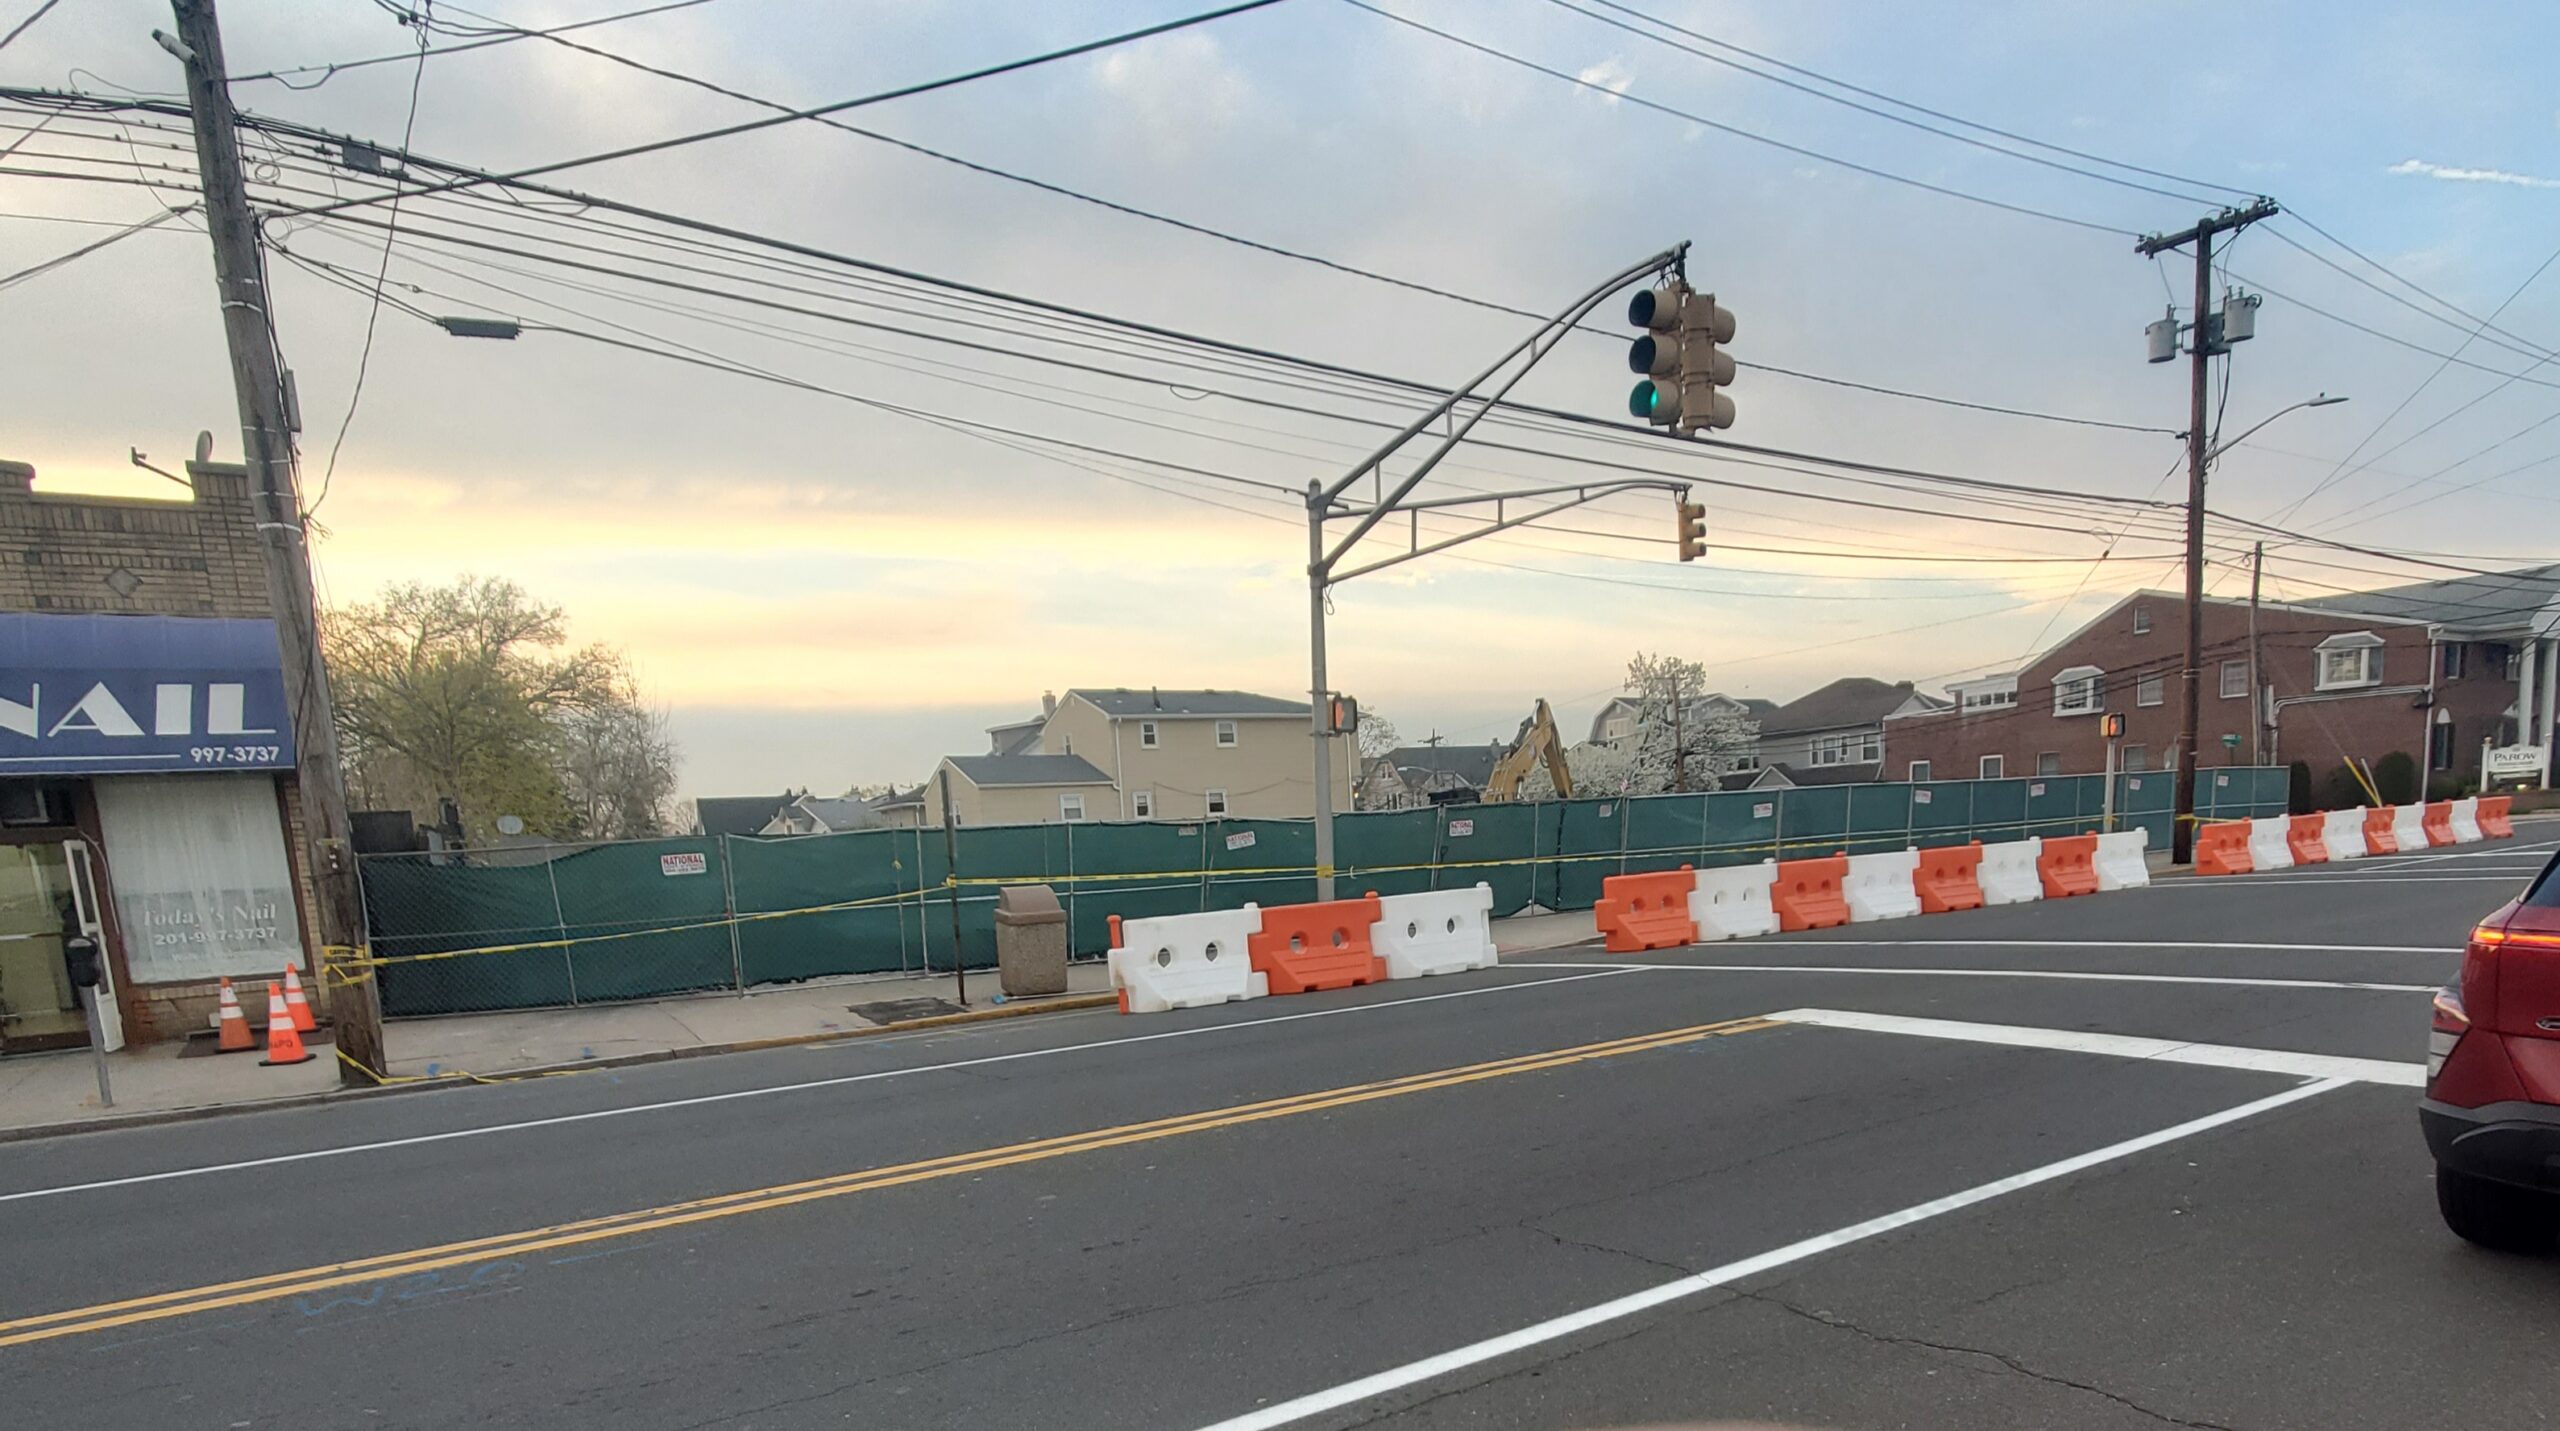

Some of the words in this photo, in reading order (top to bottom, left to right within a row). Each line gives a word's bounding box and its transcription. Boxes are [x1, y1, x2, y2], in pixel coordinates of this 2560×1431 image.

[0, 681, 277, 740] NAIL
[190, 746, 280, 763] 997-3737
[2494, 752, 2536, 762] PAROW
[663, 855, 703, 865] NATIONAL
[234, 903, 276, 920] Nail
